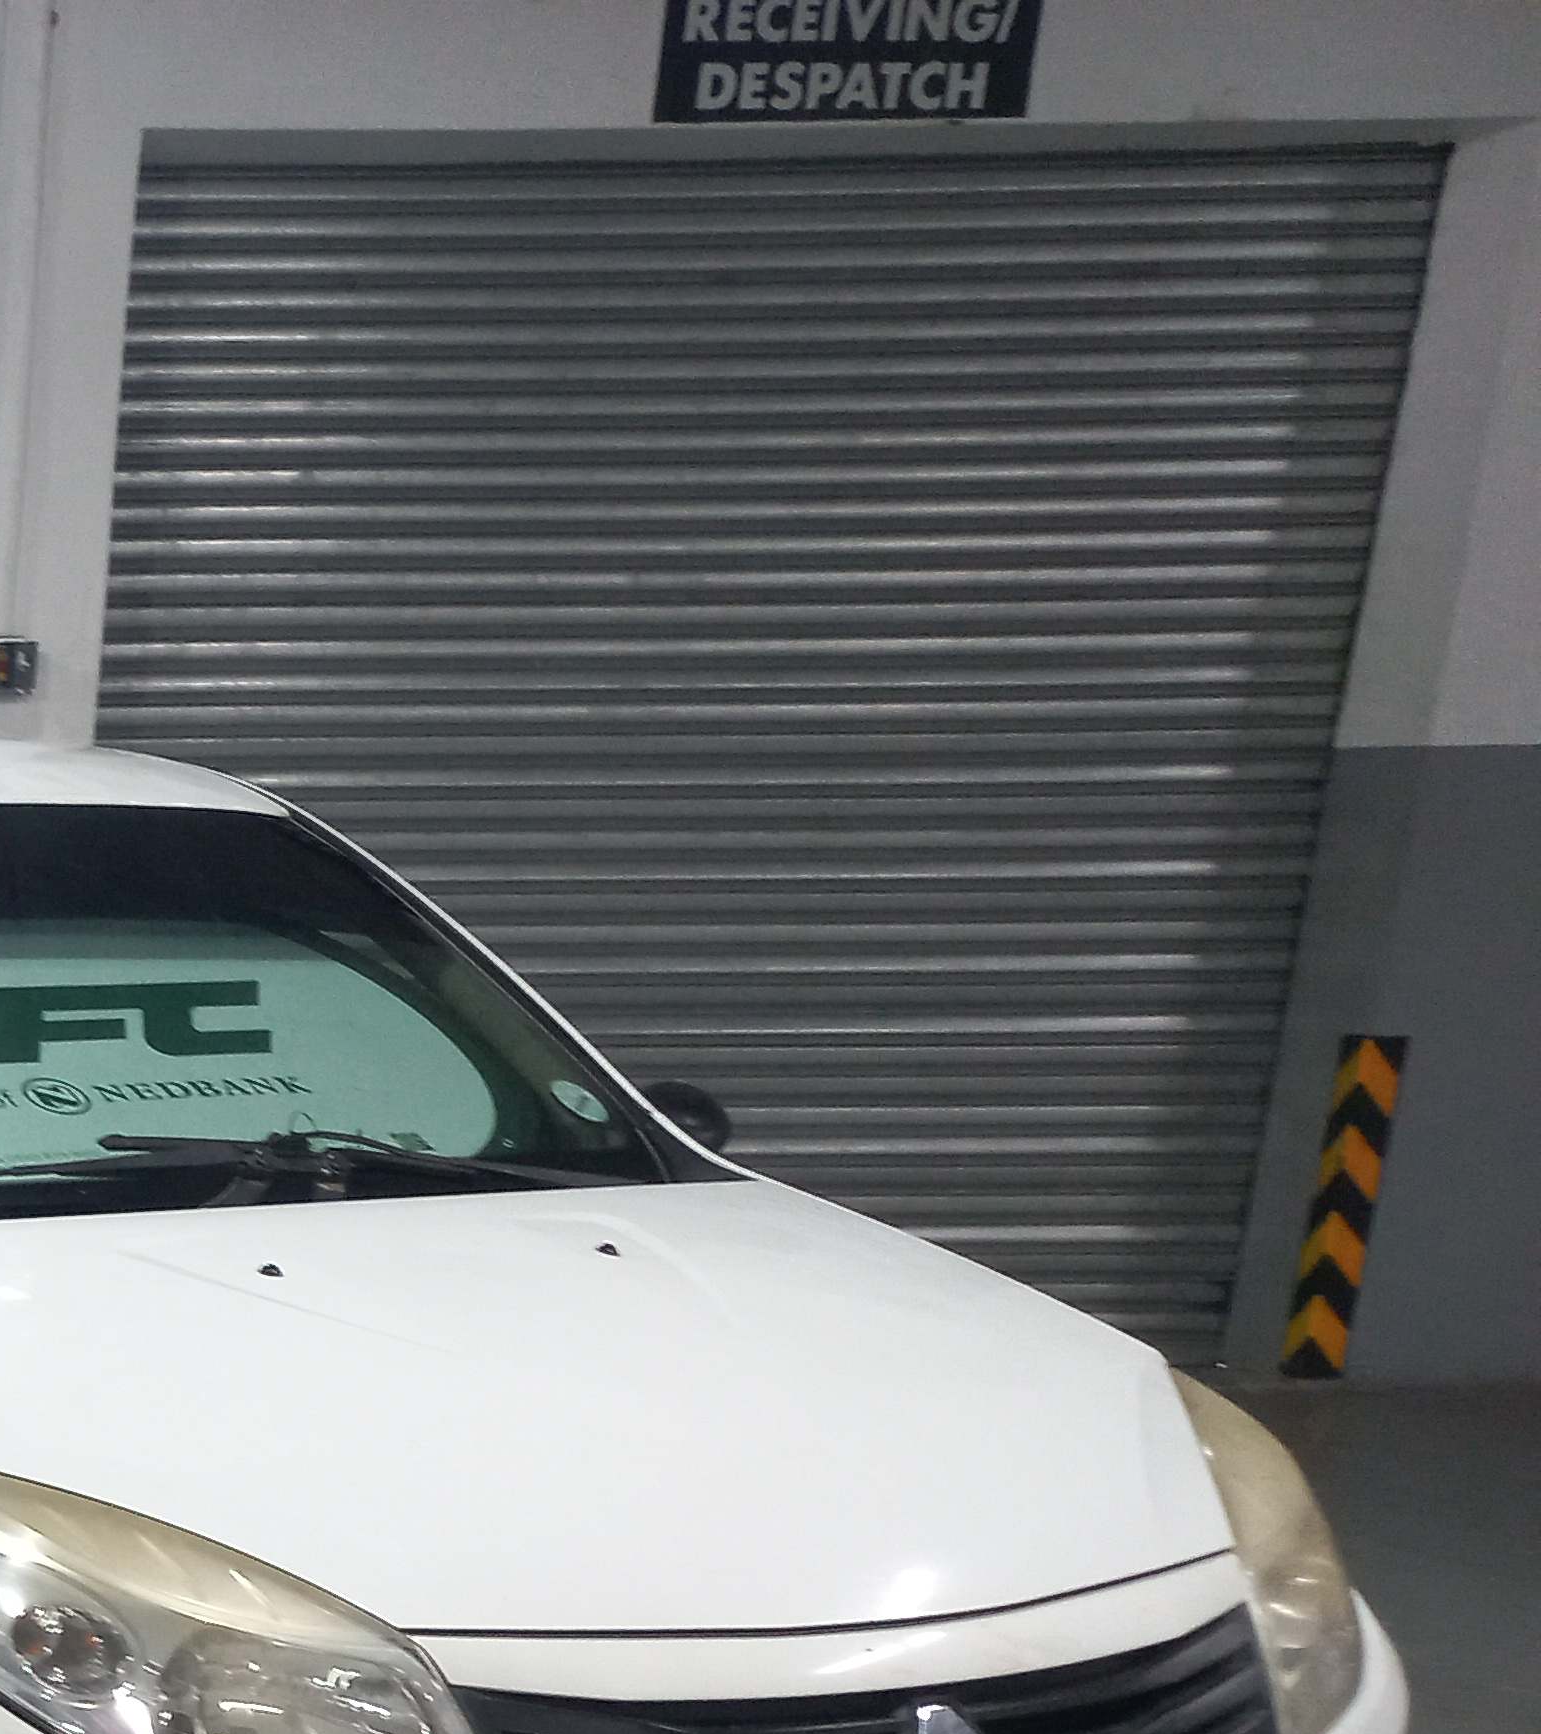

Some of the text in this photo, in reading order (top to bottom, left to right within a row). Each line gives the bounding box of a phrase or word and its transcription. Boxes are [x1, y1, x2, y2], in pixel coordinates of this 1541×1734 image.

[681, 0, 1017, 43] RECEIVING/
[694, 60, 990, 111] DESPATCH
[90, 1074, 314, 1104] NEDBANK
